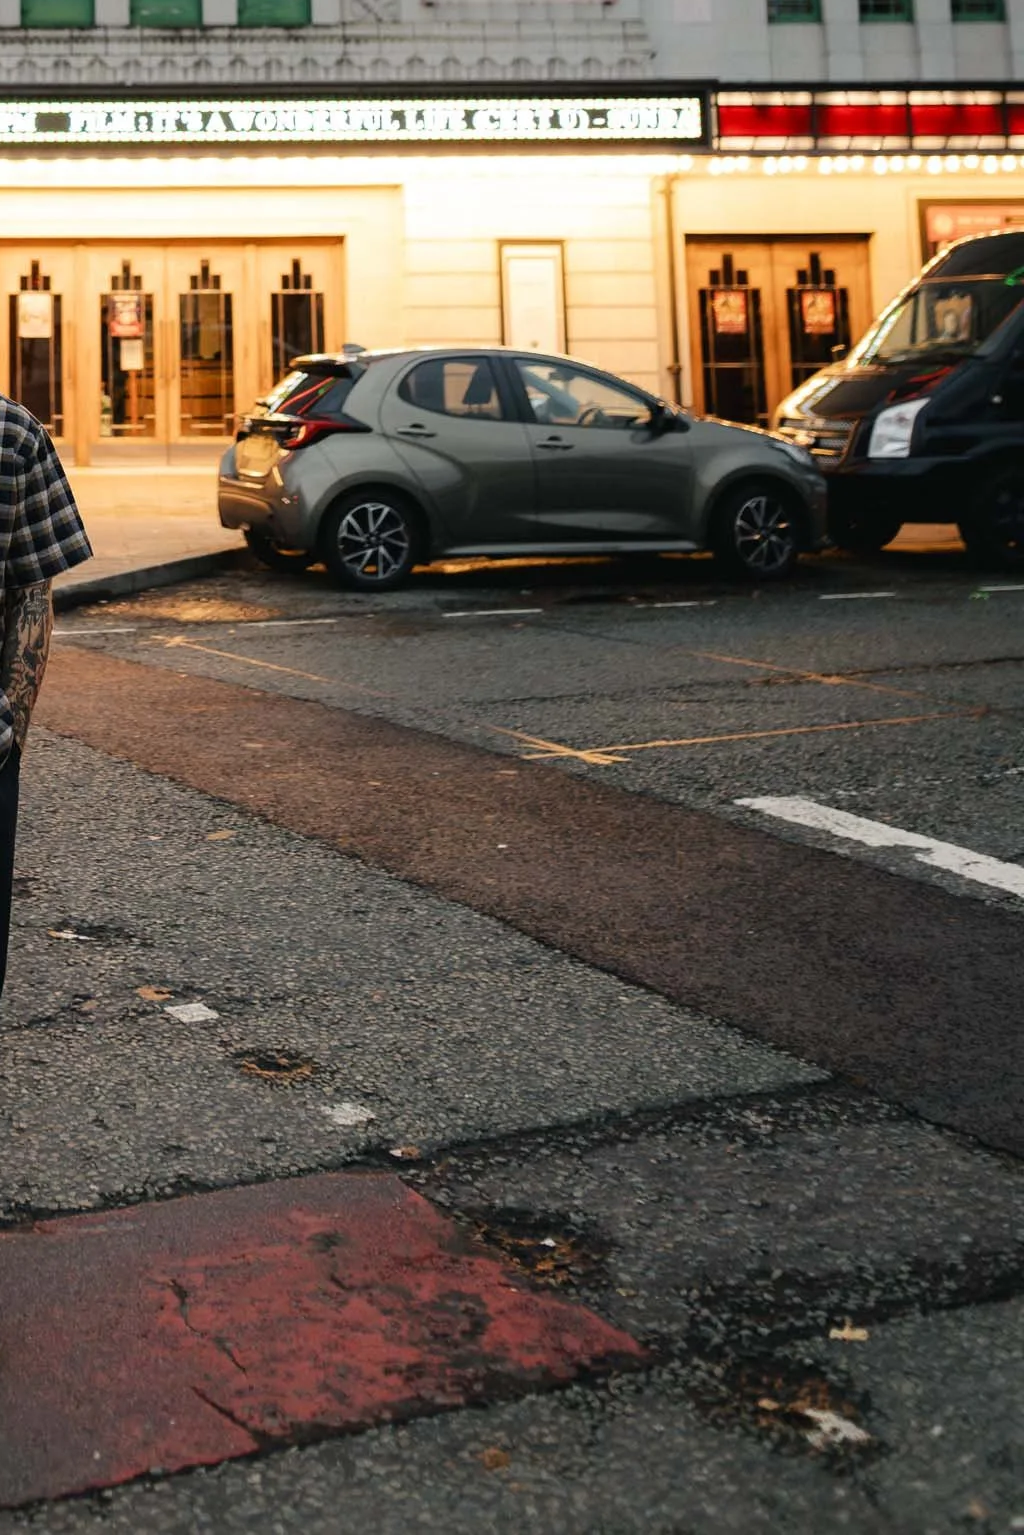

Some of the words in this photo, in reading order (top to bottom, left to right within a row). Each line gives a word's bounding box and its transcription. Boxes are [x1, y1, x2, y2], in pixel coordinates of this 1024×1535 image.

[206, 110, 226, 132] A
[229, 109, 400, 132] WONDERFUL
[405, 109, 467, 131] LIFE
